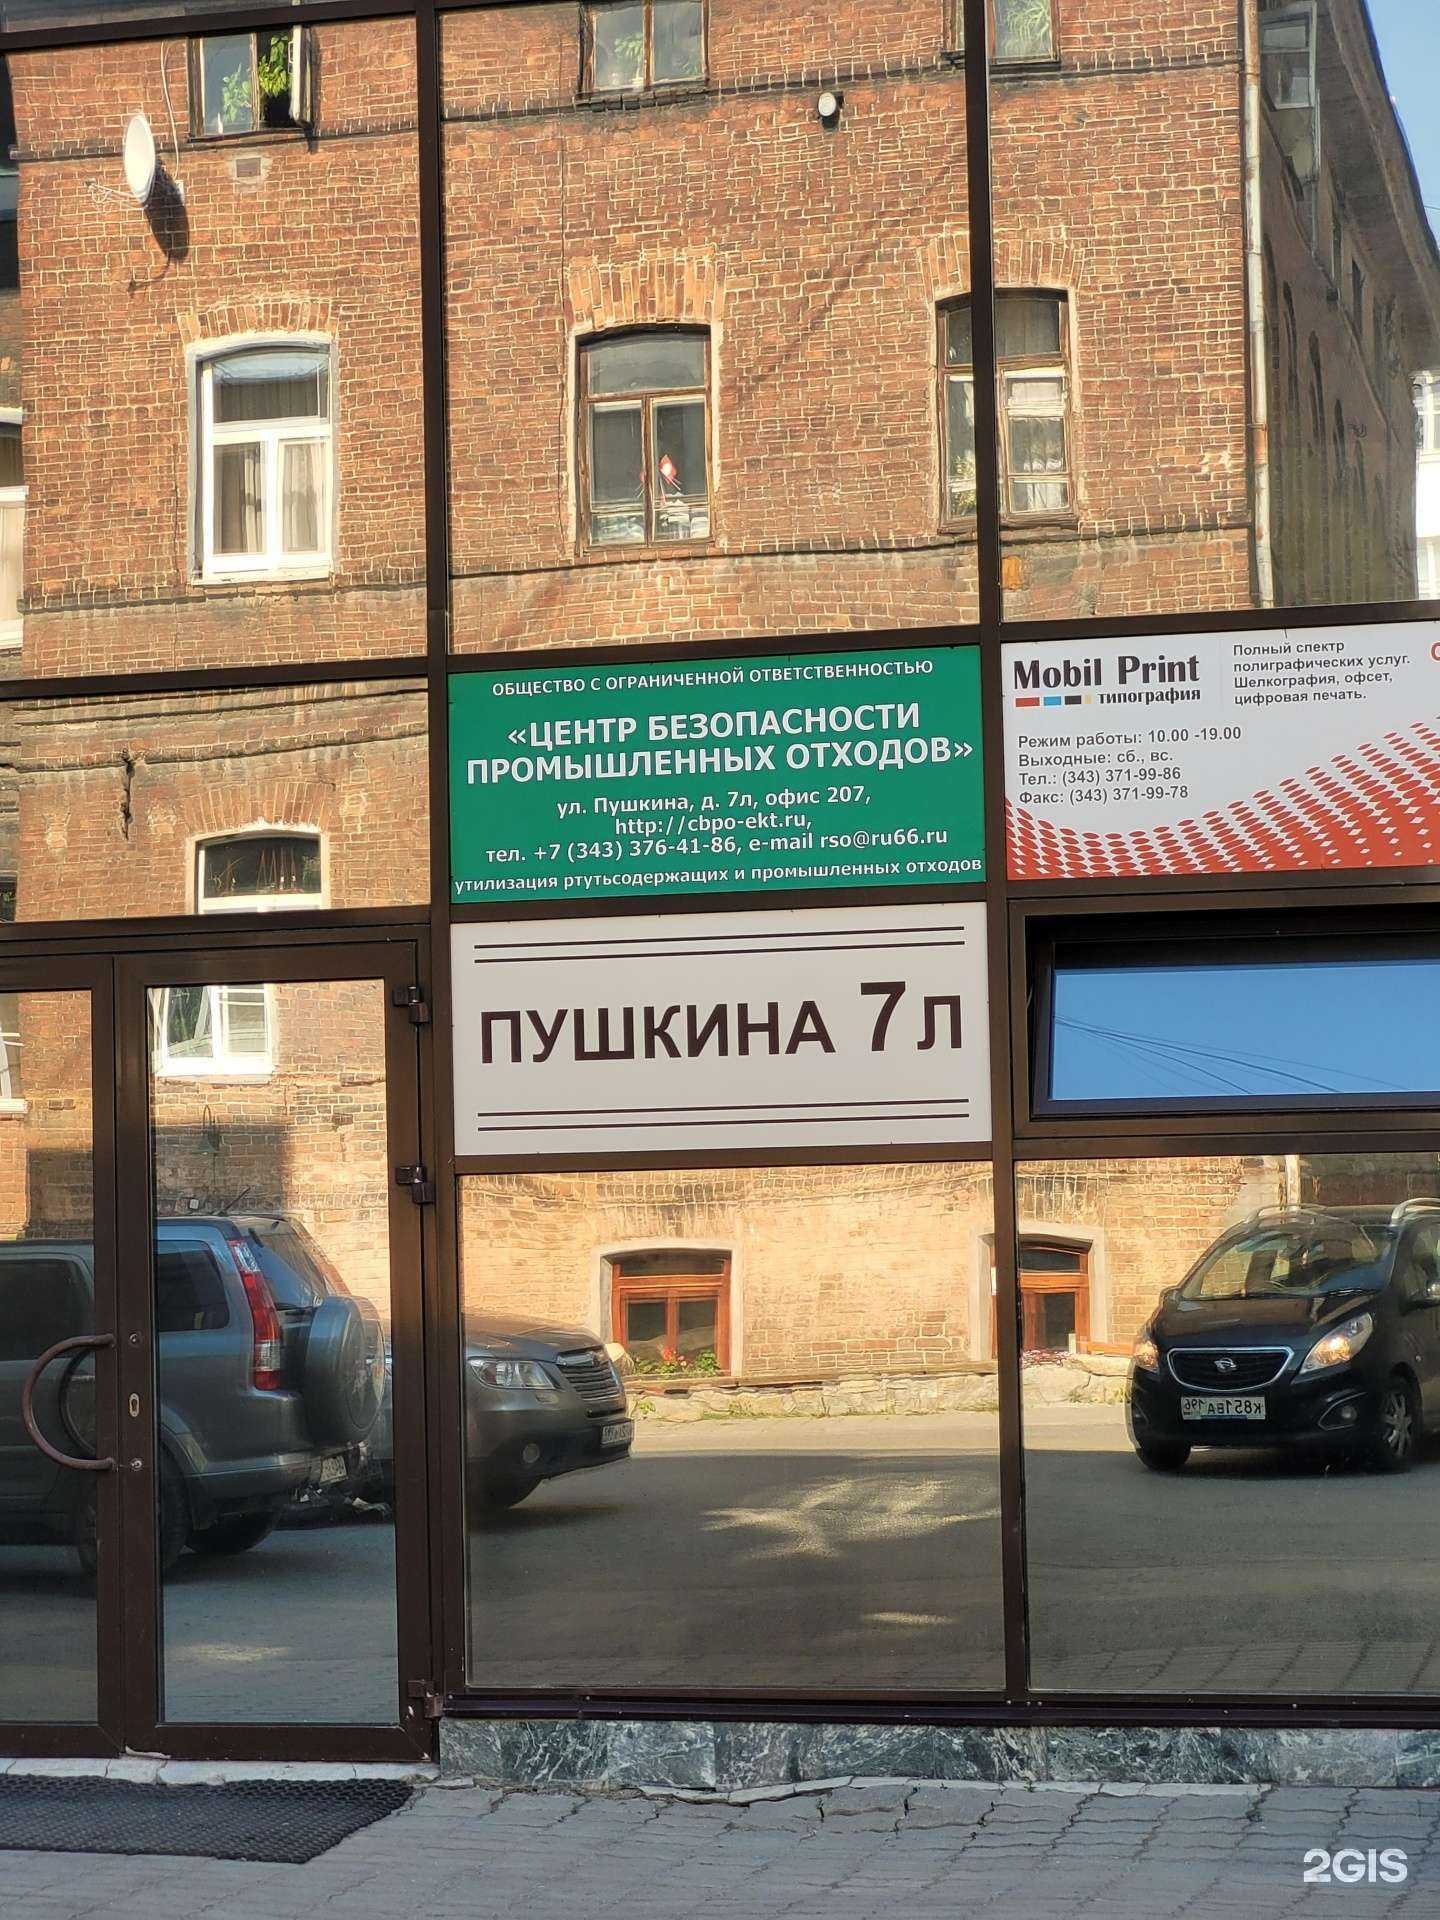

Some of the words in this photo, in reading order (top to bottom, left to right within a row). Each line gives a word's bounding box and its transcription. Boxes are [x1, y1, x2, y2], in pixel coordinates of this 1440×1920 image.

[1233, 642, 1291, 656] Полный
[1296, 641, 1345, 653] спектр
[1014, 658, 1102, 690] Mobil
[1118, 655, 1200, 685] Print
[1233, 658, 1363, 672] полиграфических
[1368, 655, 1411, 668] услуг.
[492, 678, 585, 696] ОБЩЕСТВО
[591, 677, 600, 691] С
[605, 666, 744, 690] ОГРАНИЧЕННОЙ
[750, 660, 933, 682] ОТВЕТСТВЕННОСТЬЮ
[1234, 674, 1340, 689] Шелкография,
[1344, 672, 1393, 684] офсет,
[1097, 687, 1201, 706] типография
[1234, 693, 1308, 706] цифровая
[1313, 690, 1367, 701] печать.
[507, 717, 637, 751] «ЦЕНТР
[649, 702, 920, 741] БЕЗОПАСНОСТИ
[1018, 735, 1071, 748] Режим
[1076, 732, 1142, 749] работы:
[1148, 729, 1189, 743] 10.00
[1194, 726, 1242, 741] -19.00
[466, 745, 776, 784] ПРОМЫШЛЕННЫХ
[786, 737, 973, 771] ОТХОДОВ»
[1018, 753, 1111, 767] Выходные:
[1117, 750, 1145, 764] сб.,
[1150, 751, 1173, 761] вс.
[1019, 772, 1057, 786] Тел.:
[1062, 769, 1100, 787] (343)
[1105, 767, 1181, 783] 371-99-86
[557, 801, 587, 819] ул.
[594, 796, 695, 816] Пушкина,
[702, 795, 720, 811] д.
[727, 791, 758, 810] 7л,
[765, 788, 820, 809] офис
[827, 785, 871, 805] 207,
[1019, 791, 1064, 804] Факс:
[1069, 788, 1108, 805] (343)
[1113, 786, 1188, 802] 371-99-78
[615, 812, 812, 837] http://cbpo-ekt.ru,
[486, 848, 526, 863] тел.
[534, 844, 561, 861] +7
[567, 840, 623, 863] (343)
[629, 836, 742, 857] 376-41-86,
[748, 832, 813, 852] e-mail
[820, 828, 948, 849] rso@ru66.ru
[455, 876, 558, 895] утилизация
[564, 869, 728, 890] ртутьсодержащих
[734, 869, 745, 880] и
[751, 861, 900, 882] промышленных
[905, 858, 982, 873] отходов
[481, 1000, 836, 1063] ПУШКИНА
